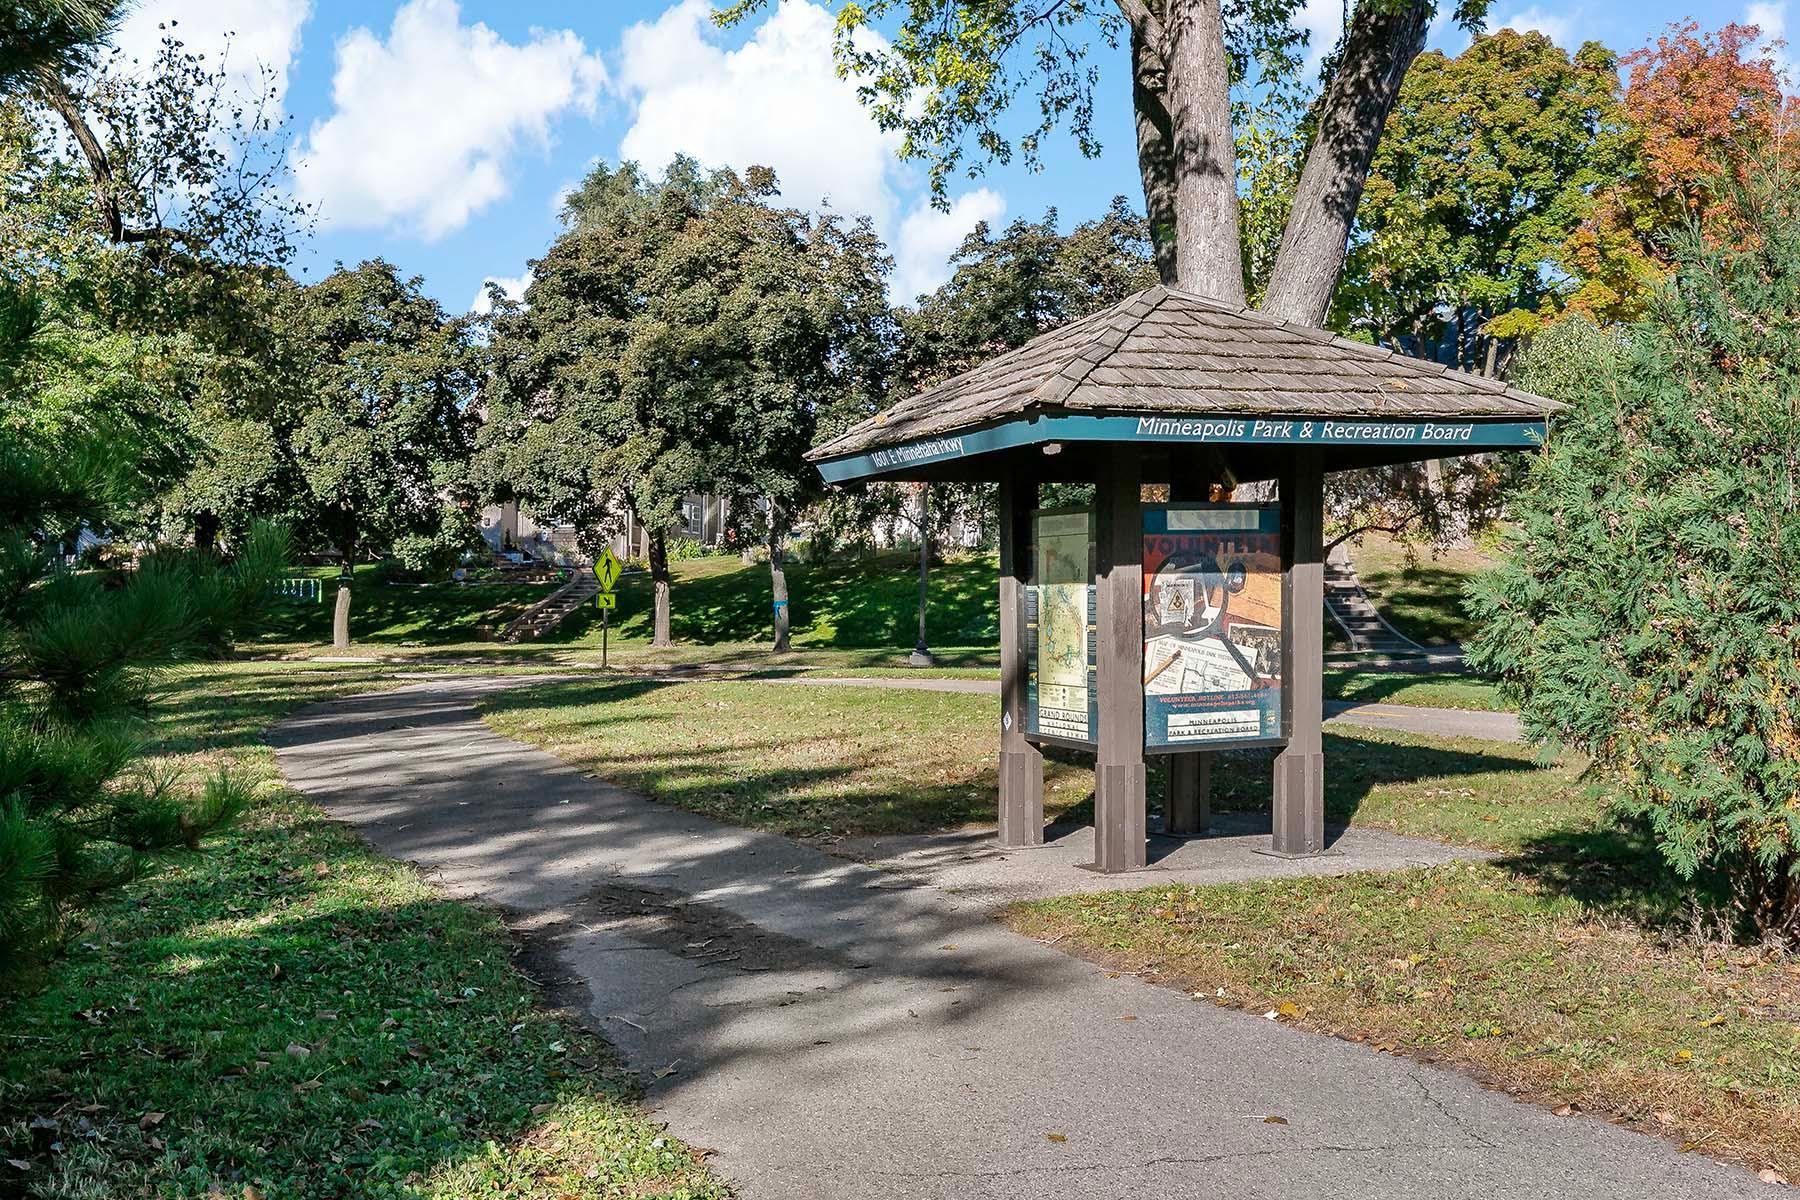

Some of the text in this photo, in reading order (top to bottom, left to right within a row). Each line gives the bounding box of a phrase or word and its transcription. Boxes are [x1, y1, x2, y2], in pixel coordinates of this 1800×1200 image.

[1136, 416, 1473, 441] Minneapolis Park & Recreation Board
[889, 449, 897, 464] E
[896, 441, 940, 463] Minnehaha
[938, 437, 965, 455] Pkwy
[1040, 709, 1087, 723] GRAND ROUNDS
[1189, 717, 1237, 725] MINNEAPOLIS
[1194, 726, 1234, 735] RECREATION
[1236, 725, 1258, 733] BOARD
